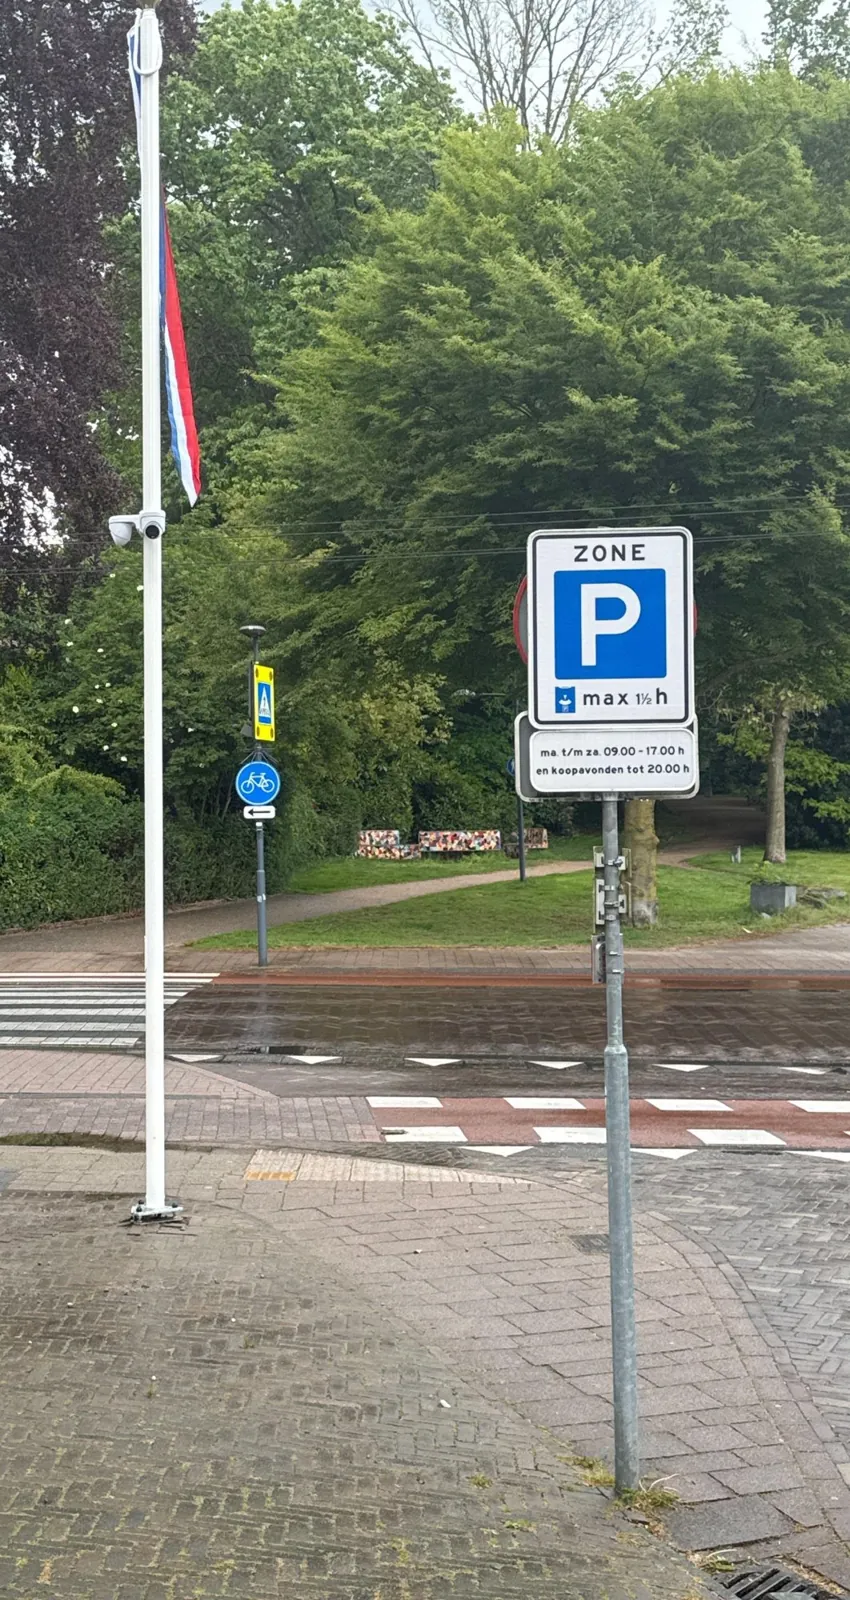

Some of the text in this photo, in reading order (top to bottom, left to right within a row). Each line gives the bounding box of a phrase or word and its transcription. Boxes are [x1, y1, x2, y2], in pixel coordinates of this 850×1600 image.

[573, 544, 646, 563] ZONE
[580, 582, 641, 667] P
[583, 693, 629, 706] max
[656, 687, 668, 705] h
[540, 749, 559, 758] ma.
[562, 747, 583, 757] t/m
[586, 749, 601, 757] za.
[604, 746, 636, 757] 09.00
[646, 746, 676, 756] 17.00
[678, 746, 685, 755] h
[536, 764, 690, 777] en koopavonden tot 20.00 h
